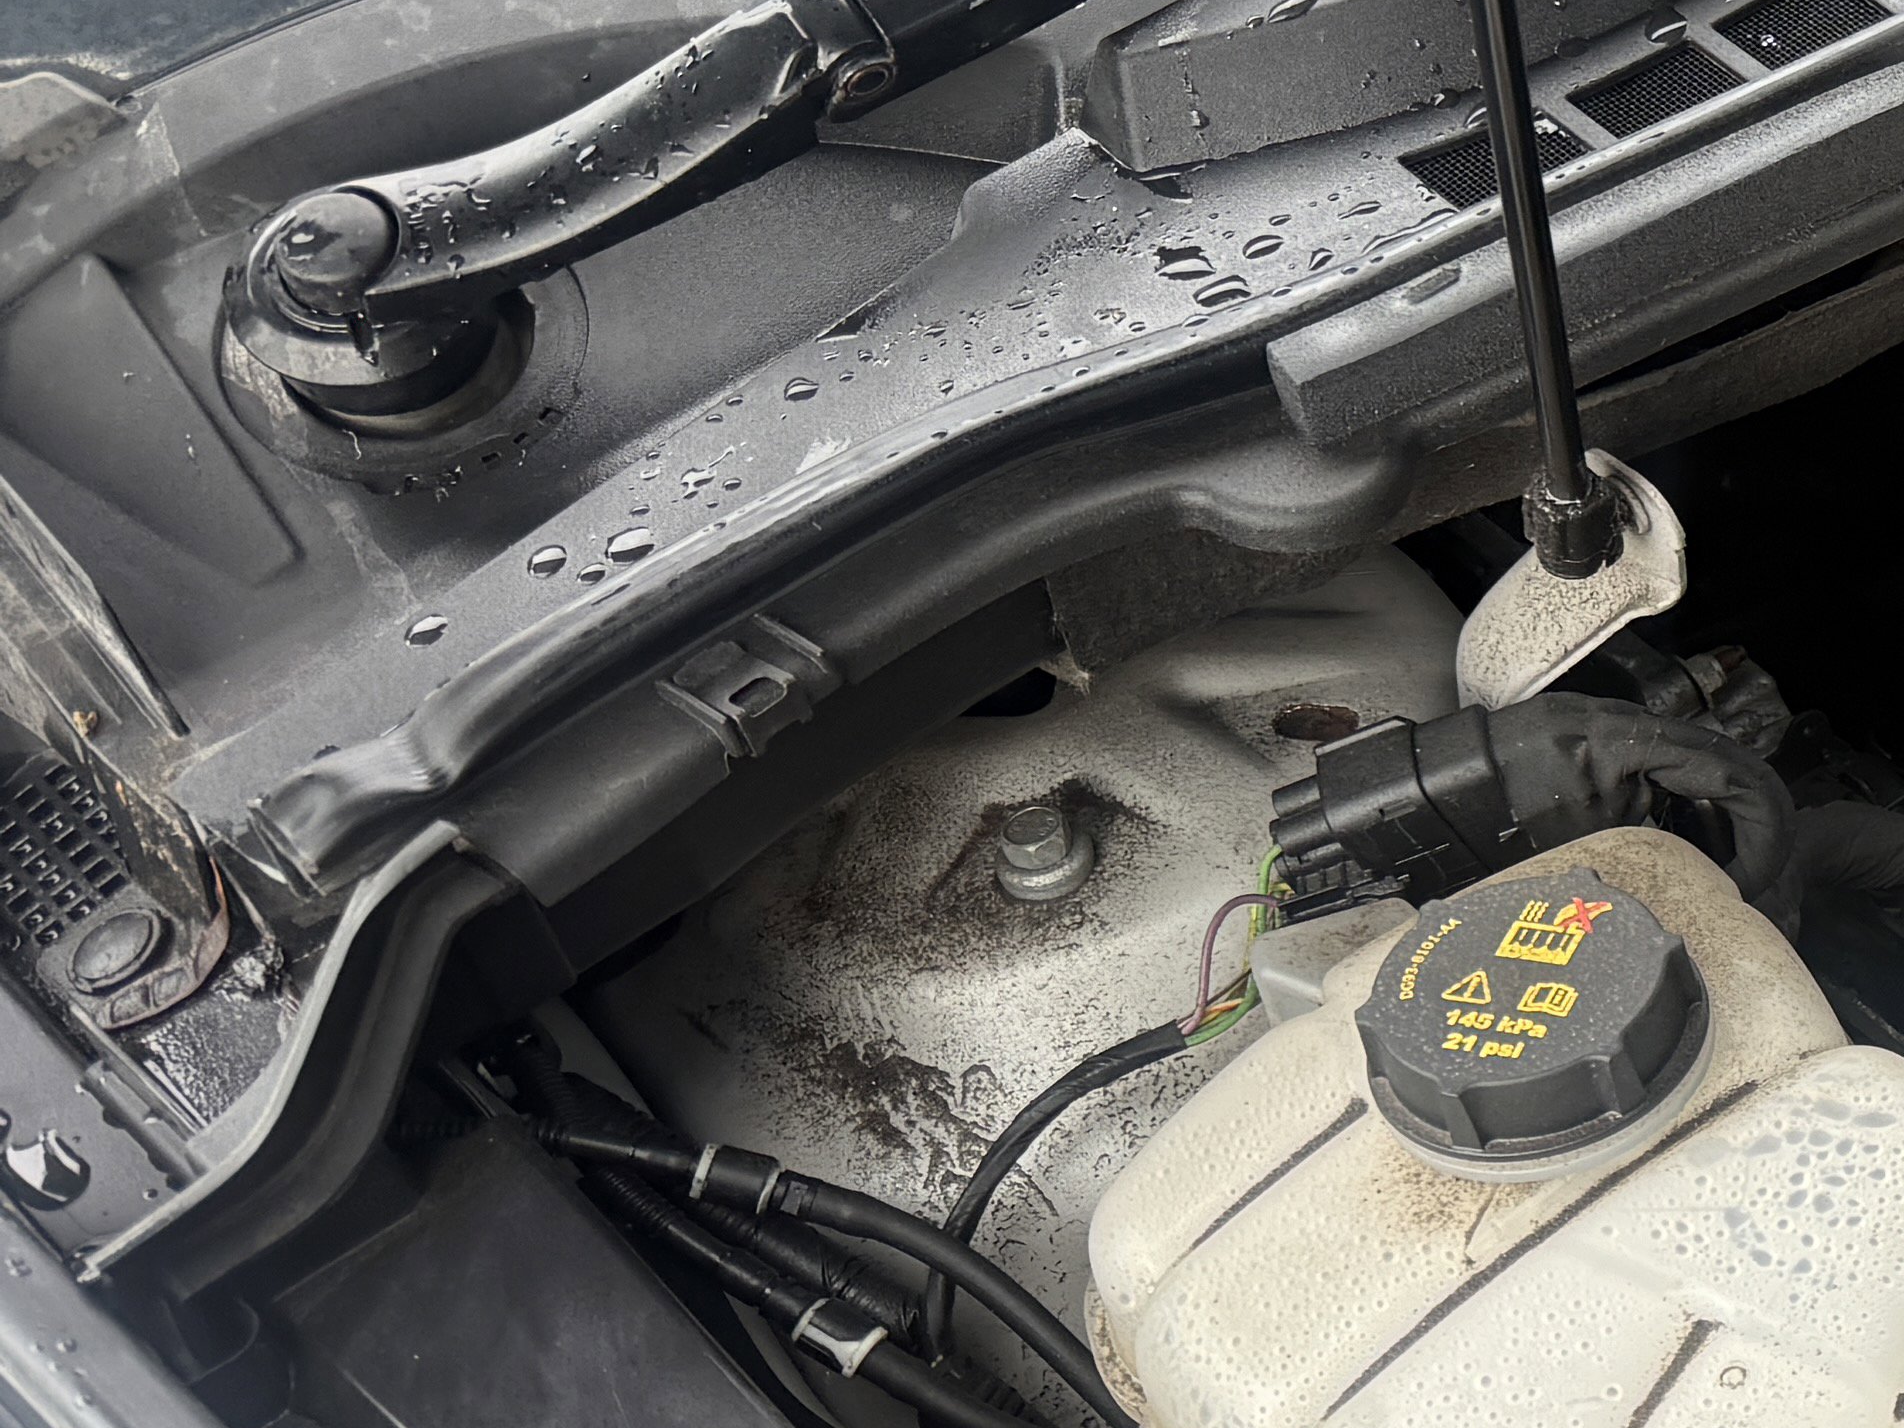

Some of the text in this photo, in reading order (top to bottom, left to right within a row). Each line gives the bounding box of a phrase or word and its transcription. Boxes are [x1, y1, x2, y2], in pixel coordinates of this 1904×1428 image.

[1446, 1008, 1548, 1039] 145 kPa
[1441, 1032, 1526, 1059] 21 psi
